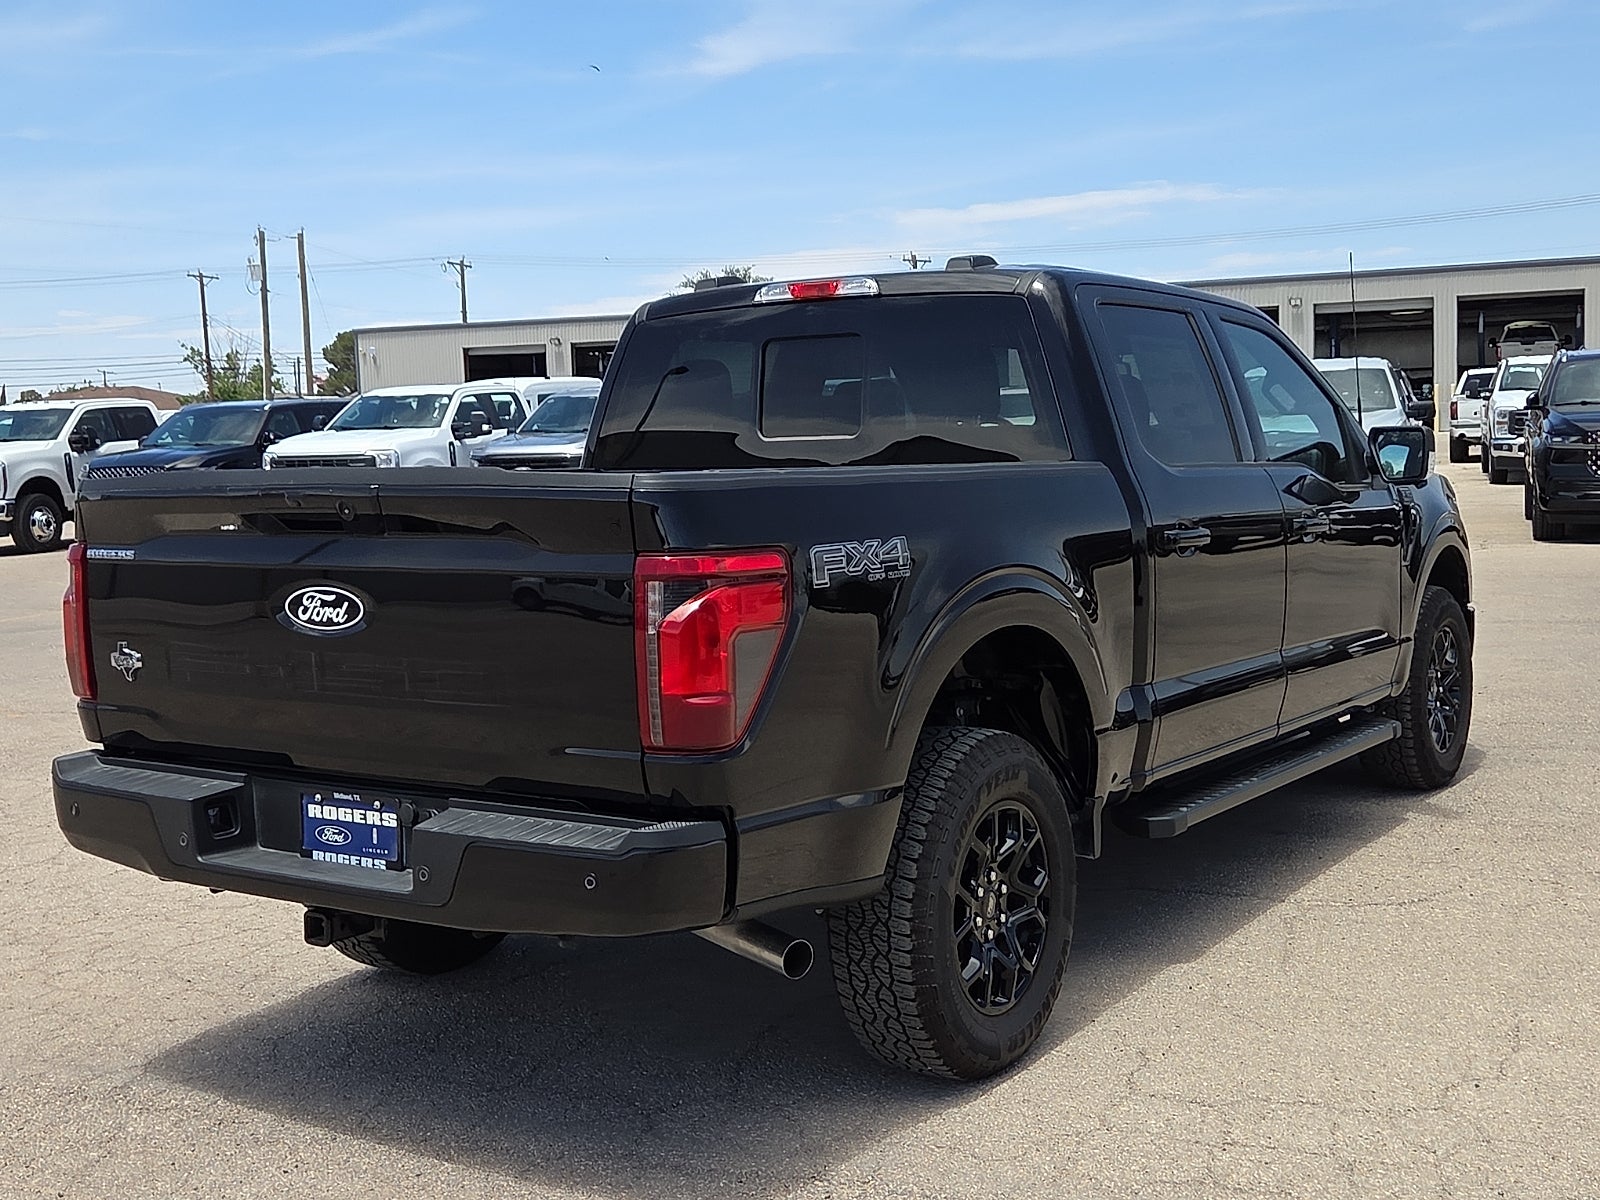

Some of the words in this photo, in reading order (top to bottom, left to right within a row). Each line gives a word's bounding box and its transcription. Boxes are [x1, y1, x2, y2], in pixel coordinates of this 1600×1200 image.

[809, 535, 911, 589] FX4
[297, 591, 350, 625] Ford
[307, 803, 398, 828] ROGERS
[321, 827, 345, 843] Ford
[312, 850, 387, 870] ROGERS
